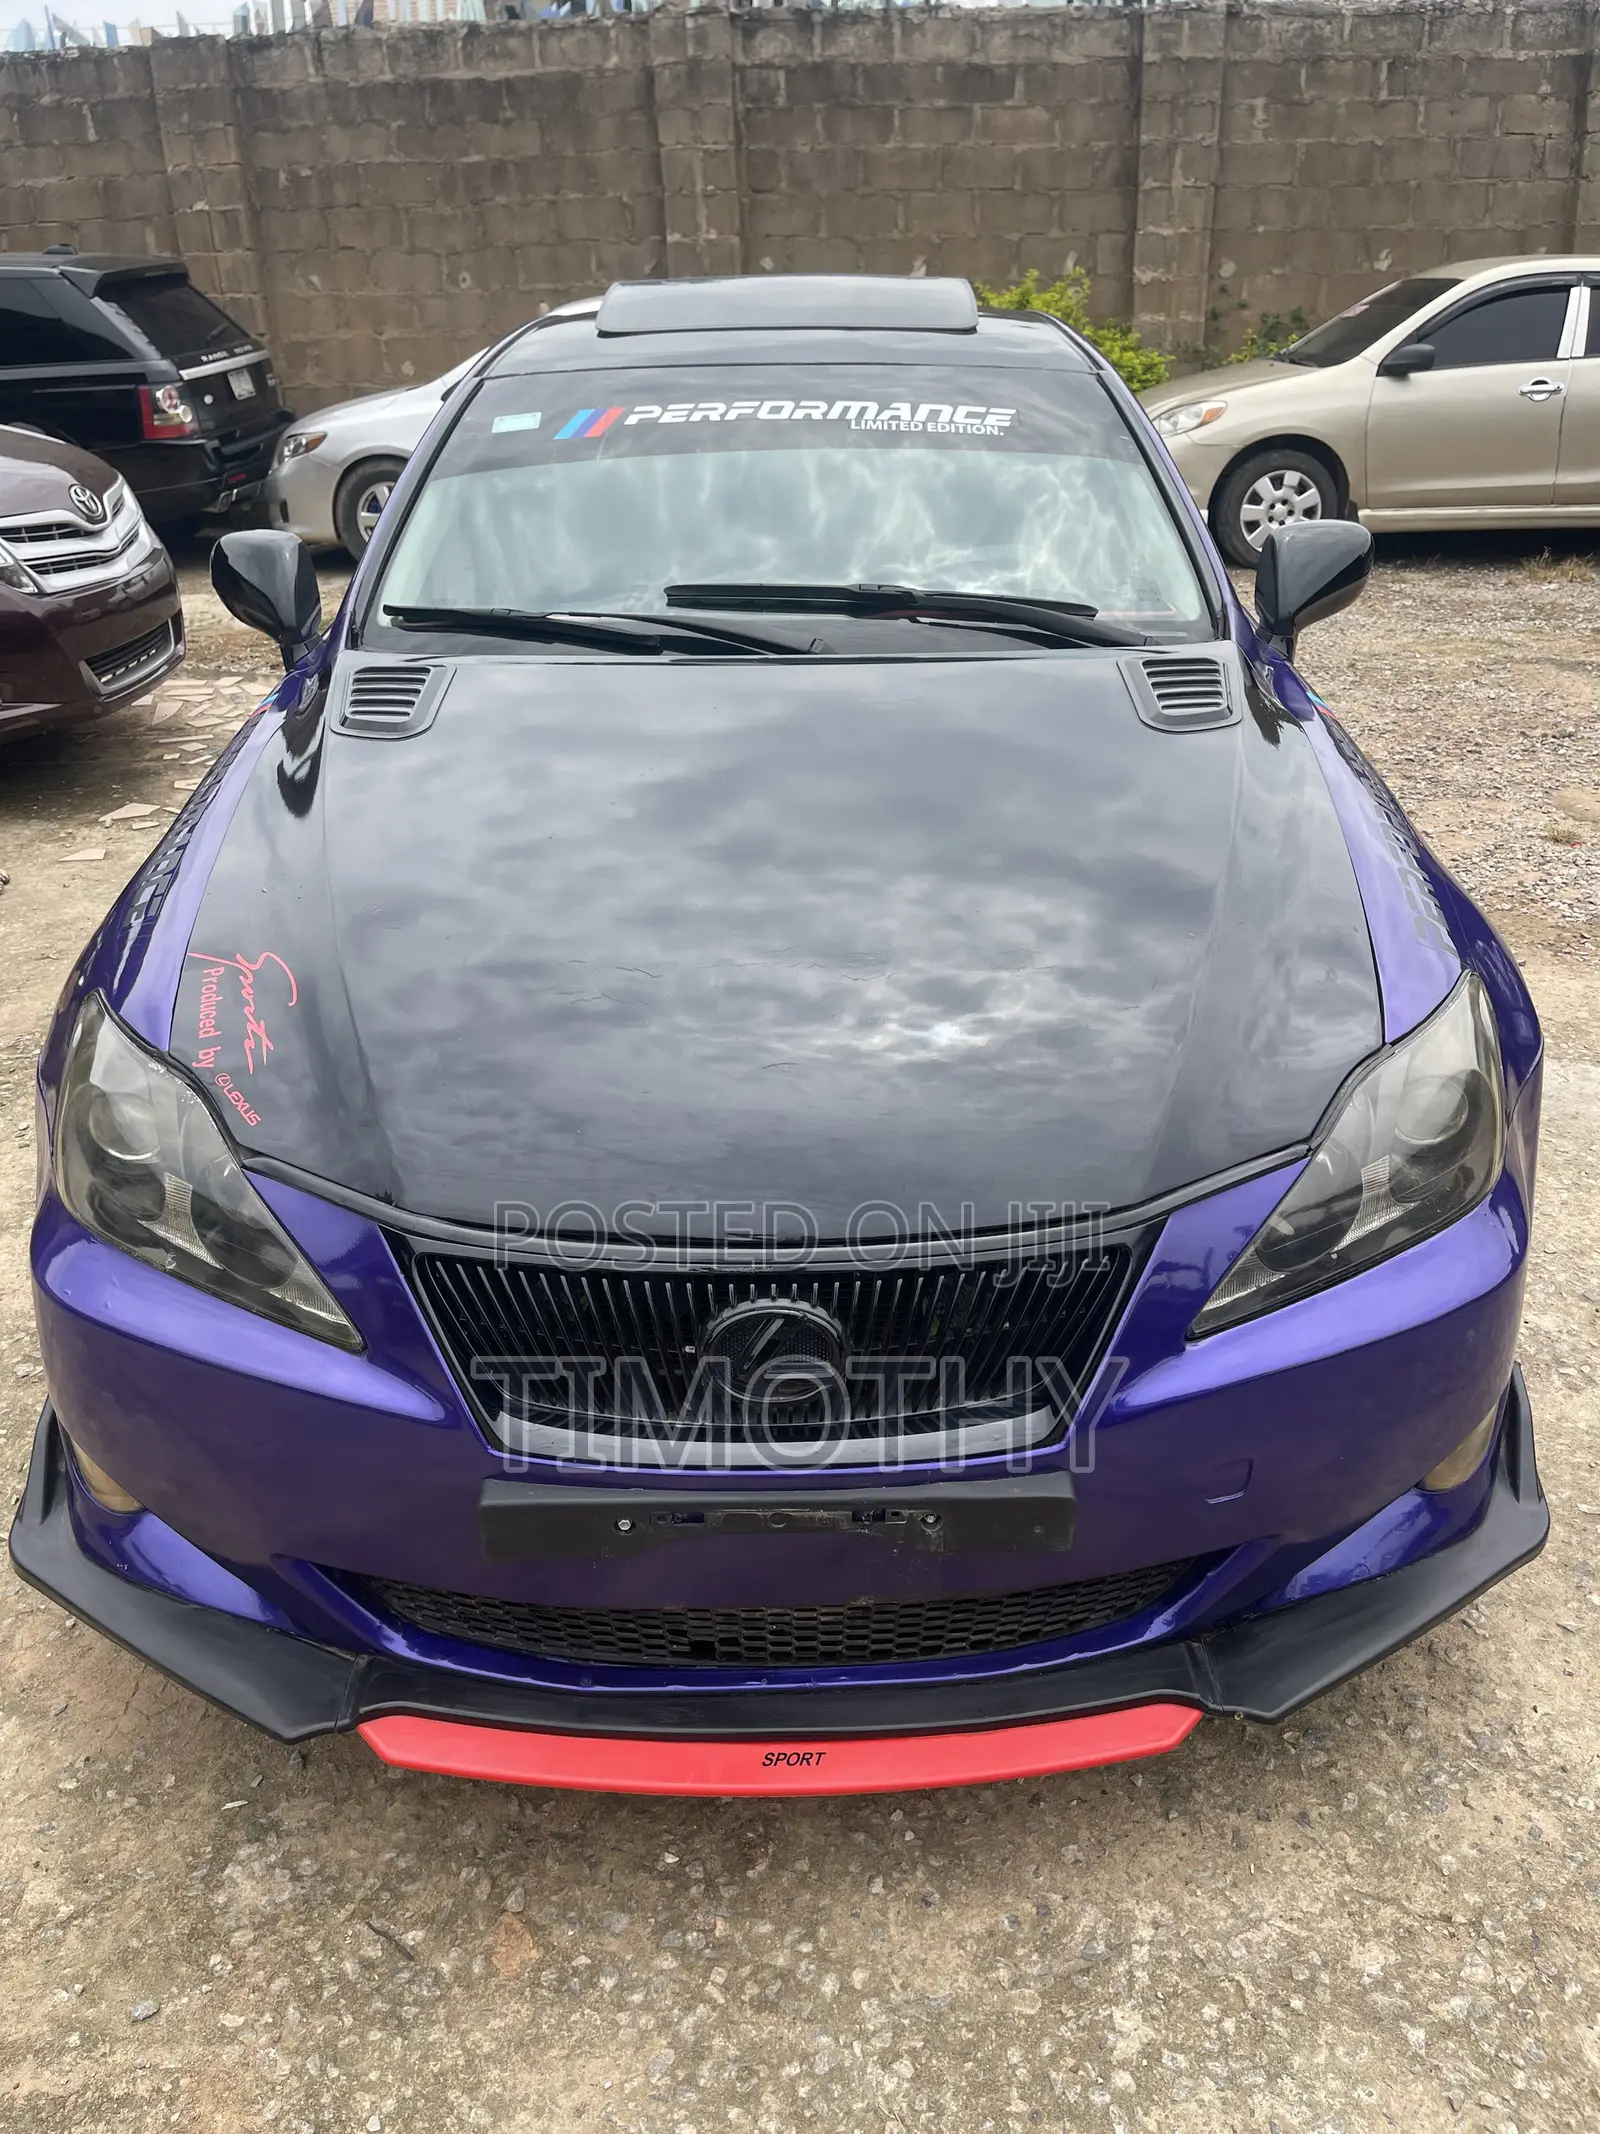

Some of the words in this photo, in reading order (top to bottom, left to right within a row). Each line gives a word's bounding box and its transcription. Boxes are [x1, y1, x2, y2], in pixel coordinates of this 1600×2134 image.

[624, 400, 1017, 427] PERFORMANCE
[850, 419, 924, 432] LIMITED
[927, 421, 1005, 436] EDITION.
[198, 966, 225, 1039] Produced
[191, 1046, 222, 1068] by
[223, 1083, 261, 1127] LEXUS
[761, 1751, 827, 1767] SPORT
